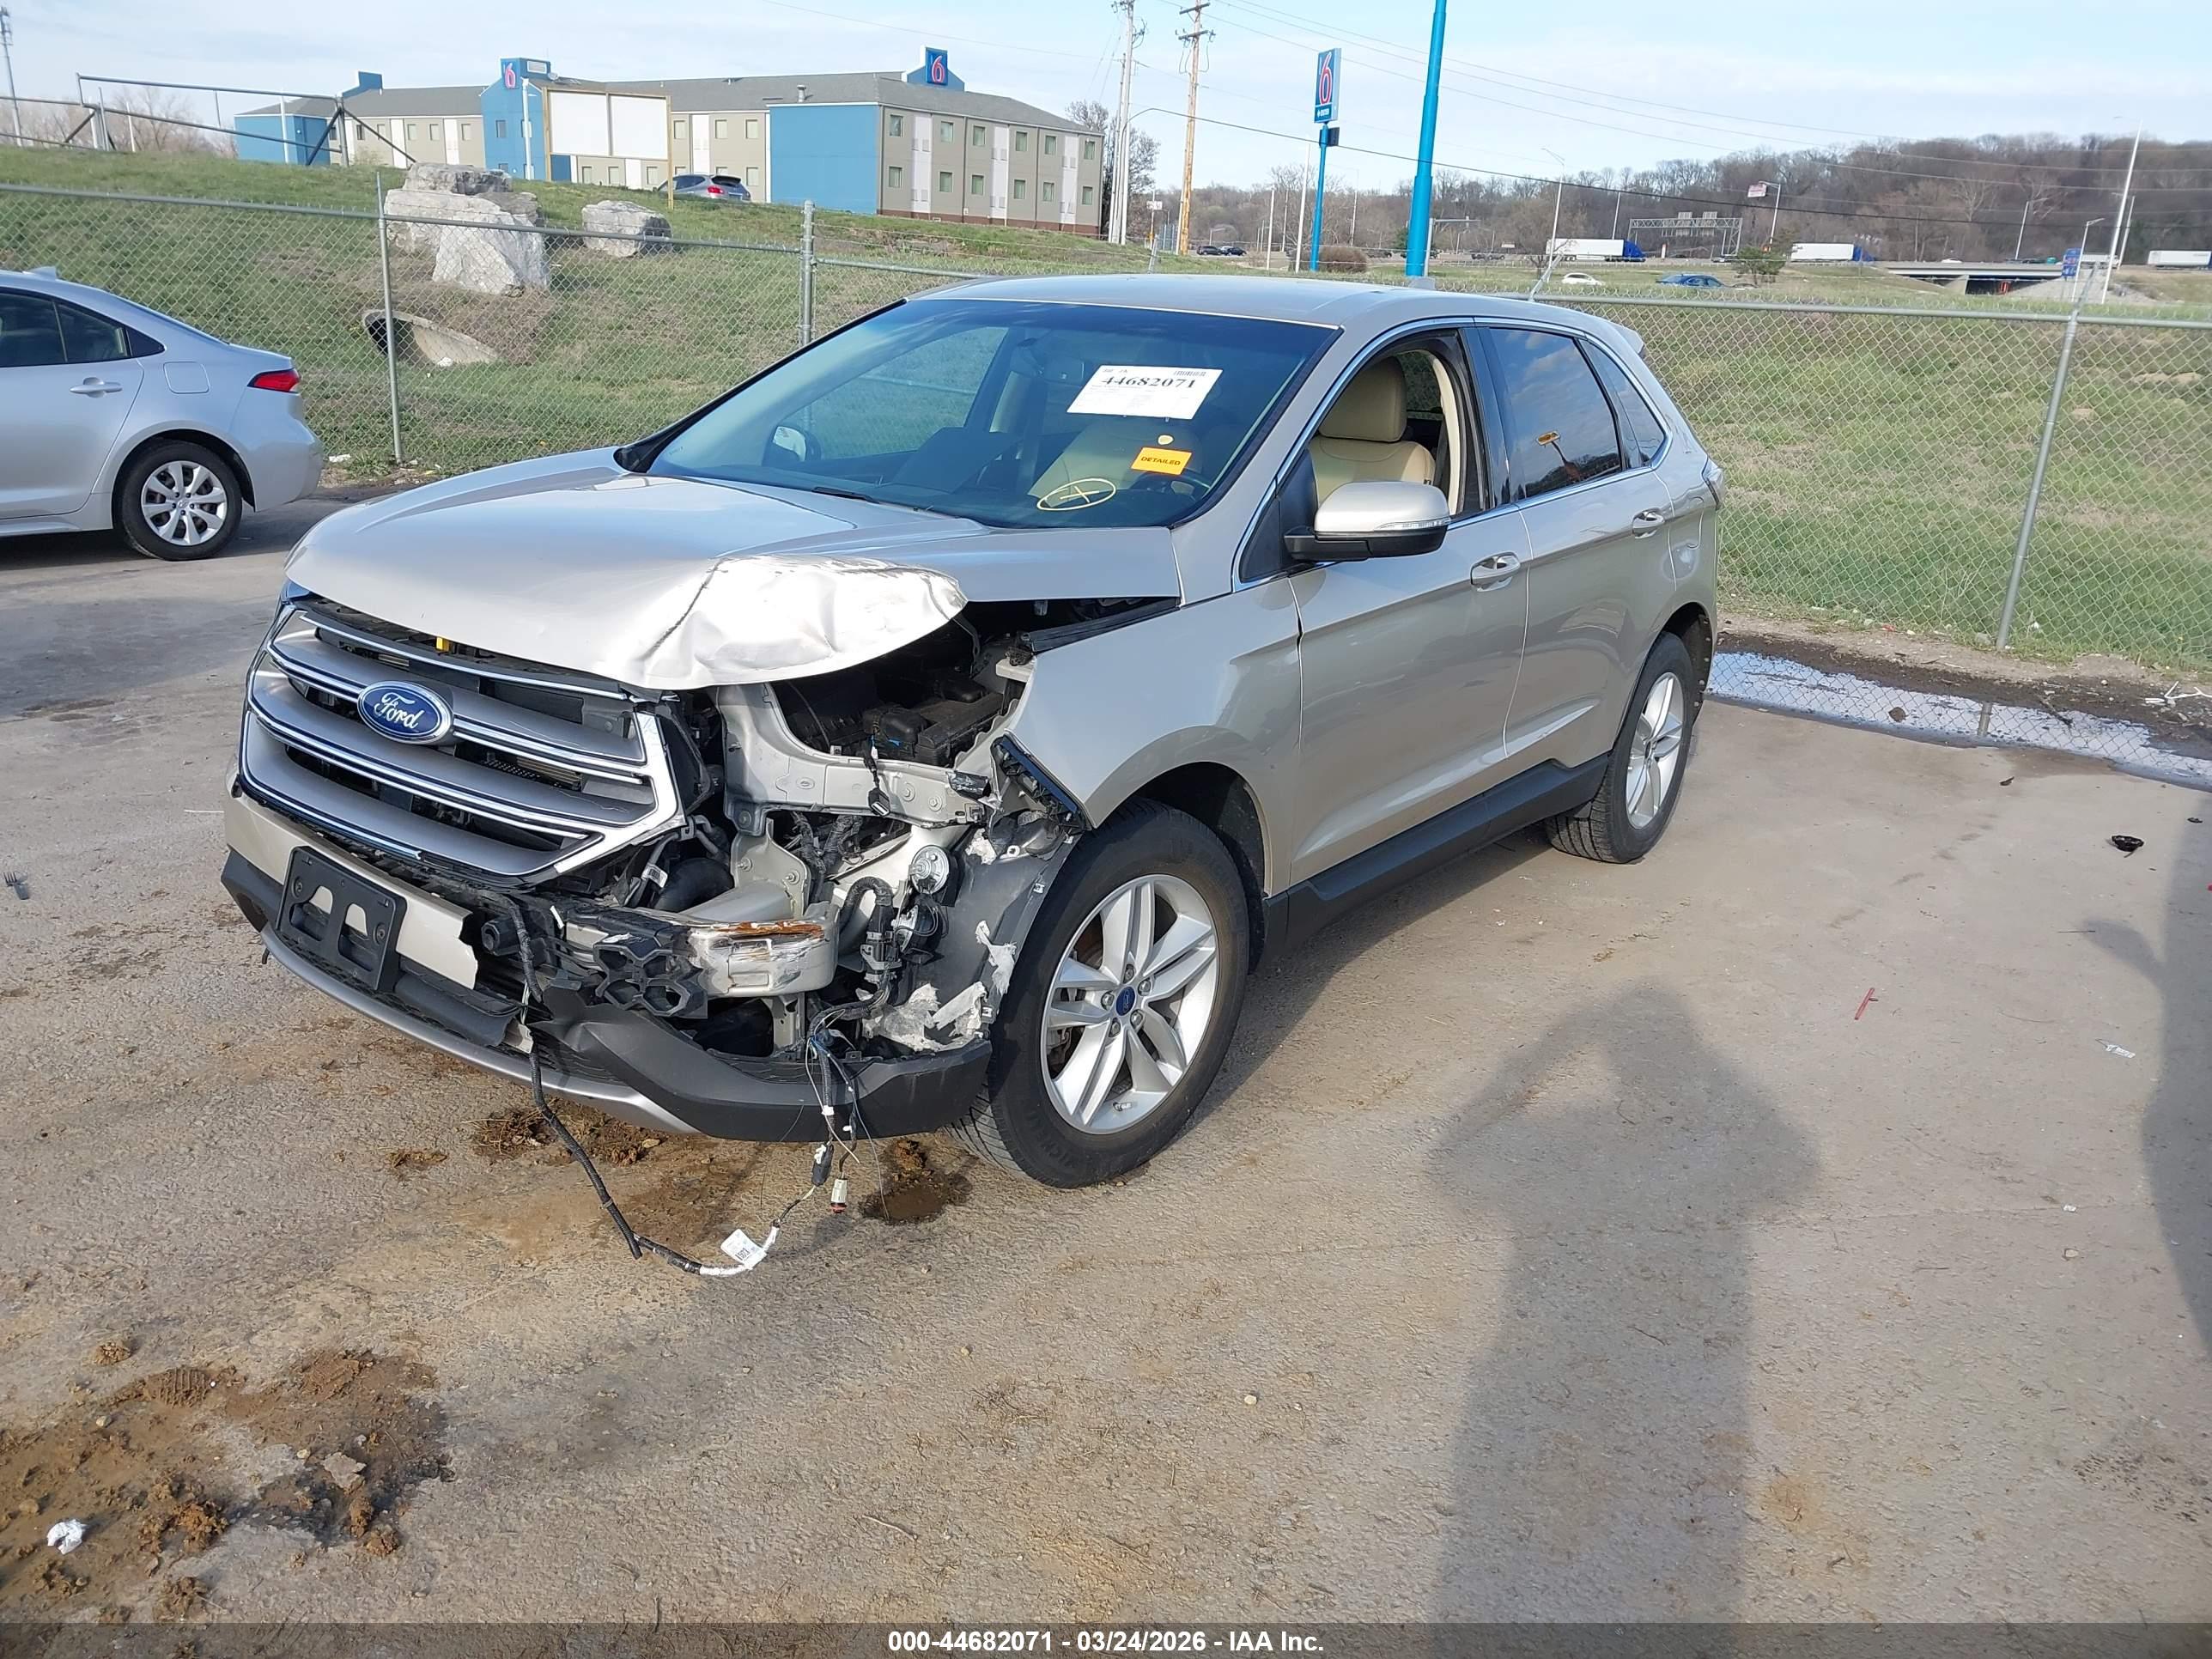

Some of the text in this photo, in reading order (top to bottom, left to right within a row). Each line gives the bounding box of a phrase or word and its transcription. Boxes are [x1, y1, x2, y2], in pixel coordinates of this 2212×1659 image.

[505, 62, 516, 89] 6
[932, 55, 945, 83] 6
[1319, 52, 1332, 105] 6
[1102, 376, 1195, 388] 44682071
[1140, 455, 1182, 466] DETAILED
[374, 692, 425, 729] Ford
